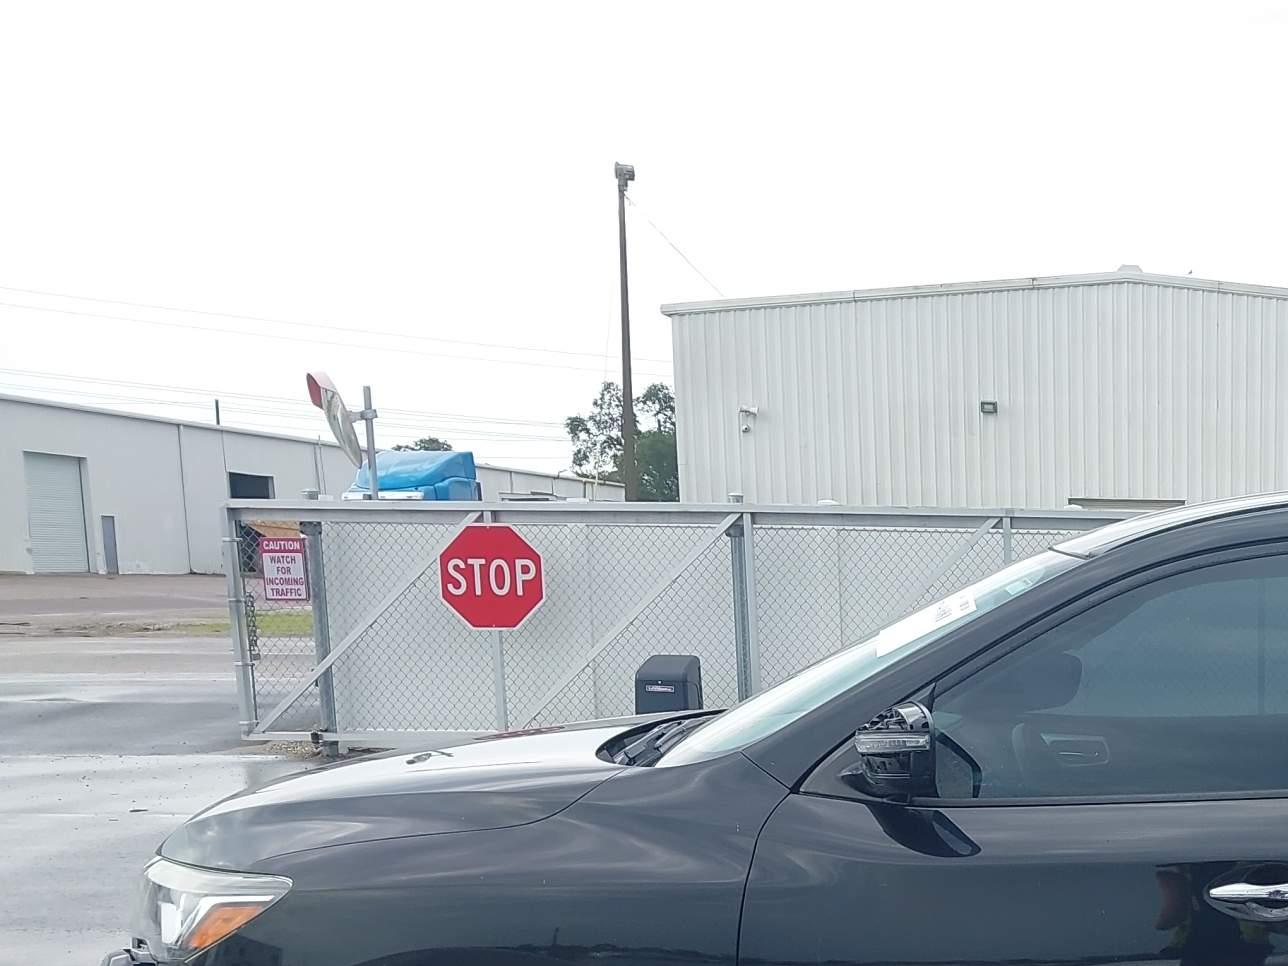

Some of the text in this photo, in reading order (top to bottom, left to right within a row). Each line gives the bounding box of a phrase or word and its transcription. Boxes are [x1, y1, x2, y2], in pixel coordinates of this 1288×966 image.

[263, 541, 301, 550] CAUTION
[270, 556, 296, 564] WATCH
[276, 566, 292, 575] FOR
[266, 577, 304, 586] INCOMING
[447, 558, 537, 596] STOP
[270, 588, 302, 597] TRAFFIC
